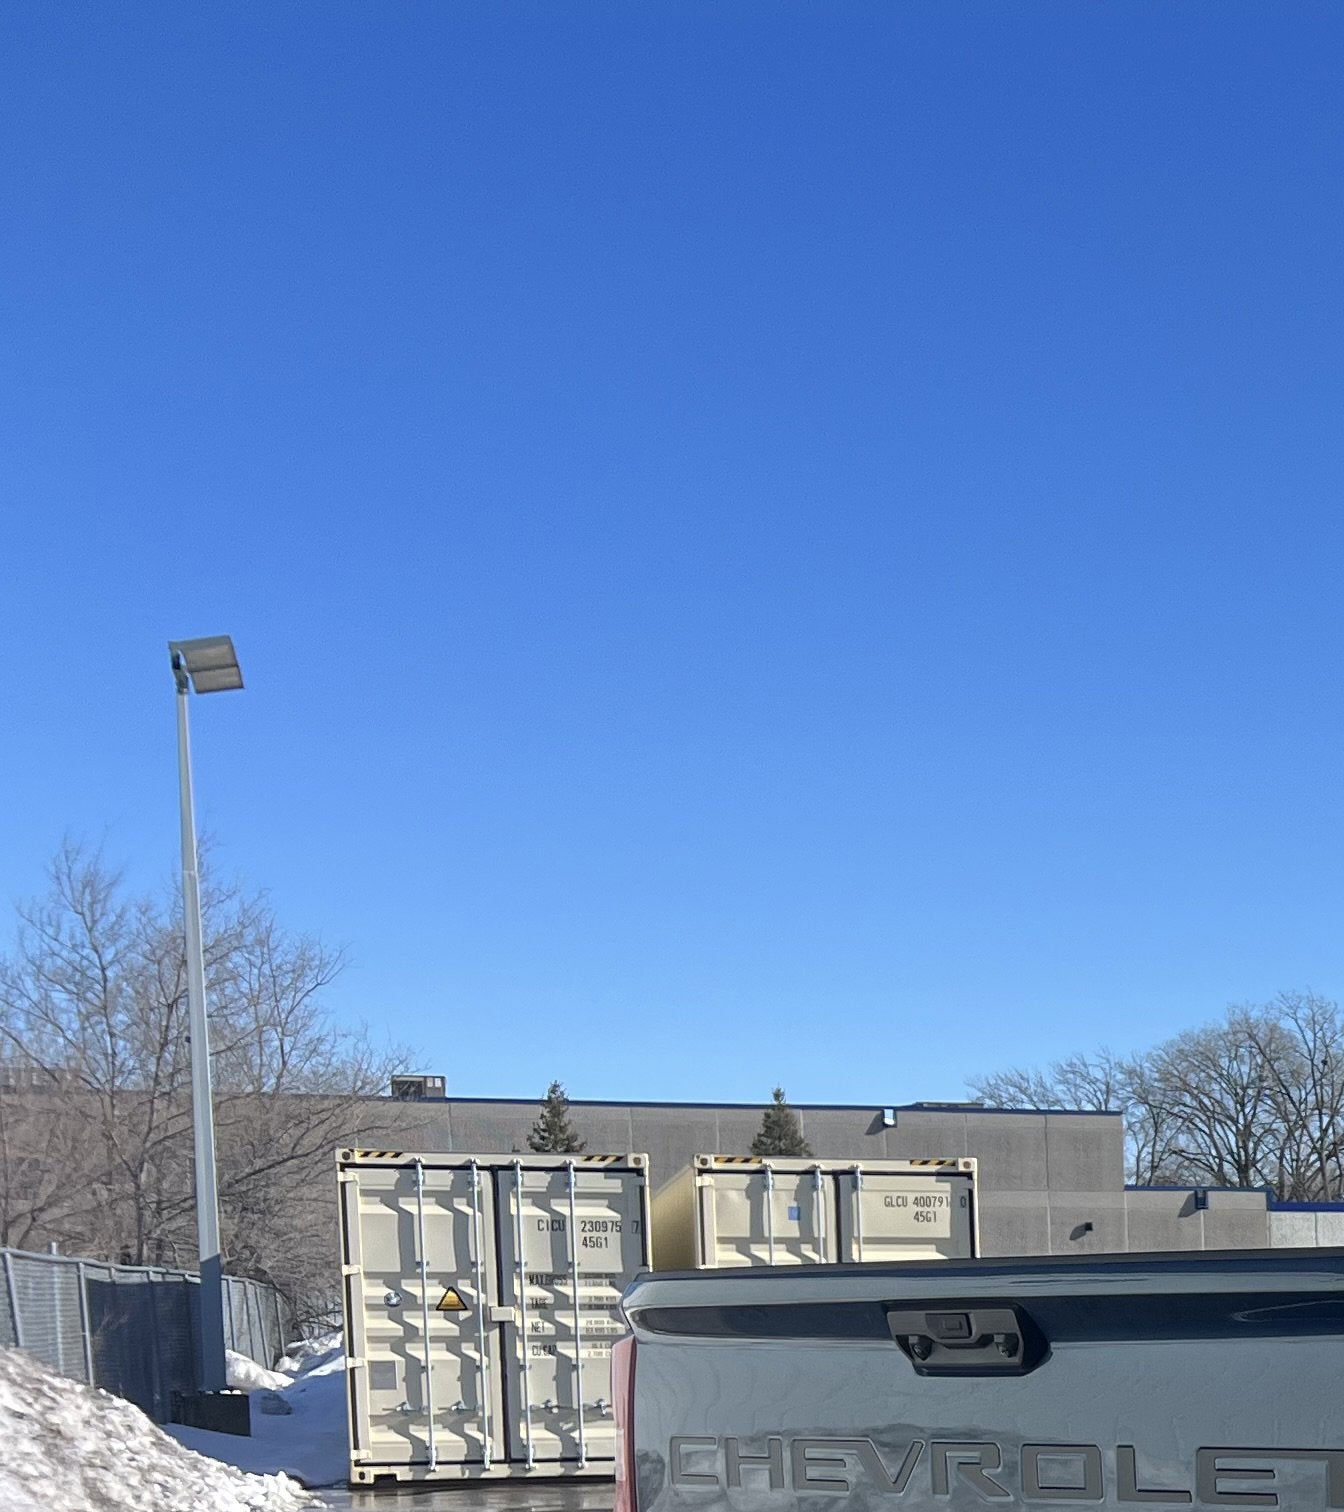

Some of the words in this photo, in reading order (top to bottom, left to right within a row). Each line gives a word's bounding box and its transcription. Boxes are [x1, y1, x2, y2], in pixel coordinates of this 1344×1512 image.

[913, 1196, 949, 1208] 400791
[913, 1211, 937, 1222] 45G1
[581, 1220, 622, 1233] 230975
[581, 1236, 609, 1249] 45G1
